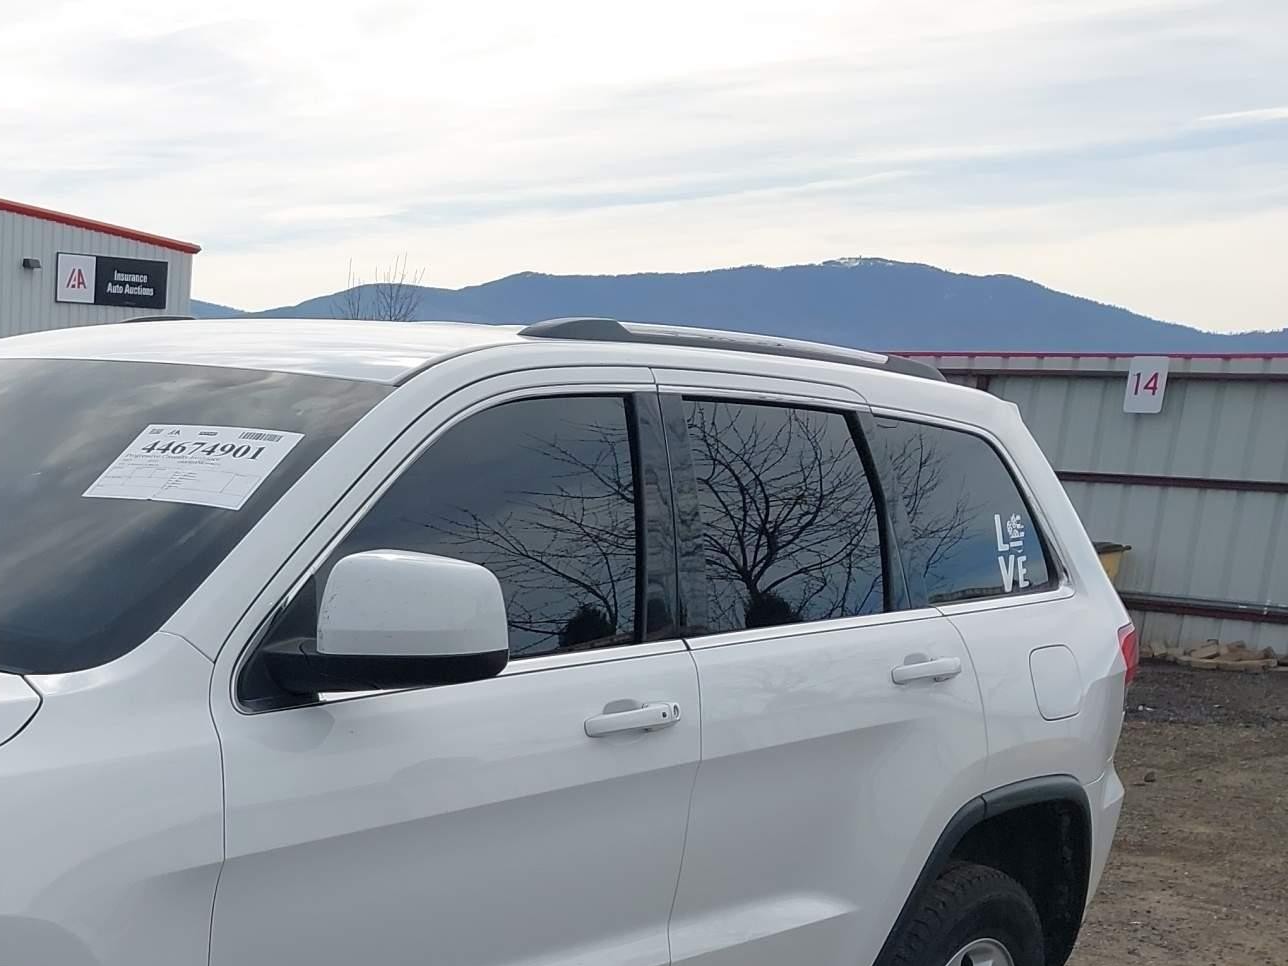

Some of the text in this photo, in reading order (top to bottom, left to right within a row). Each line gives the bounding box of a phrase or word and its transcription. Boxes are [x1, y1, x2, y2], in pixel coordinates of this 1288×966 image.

[114, 270, 148, 283] Insurance
[106, 282, 154, 296] Auto Auctions
[1133, 372, 1159, 396] 14
[141, 440, 266, 460] 44674901
